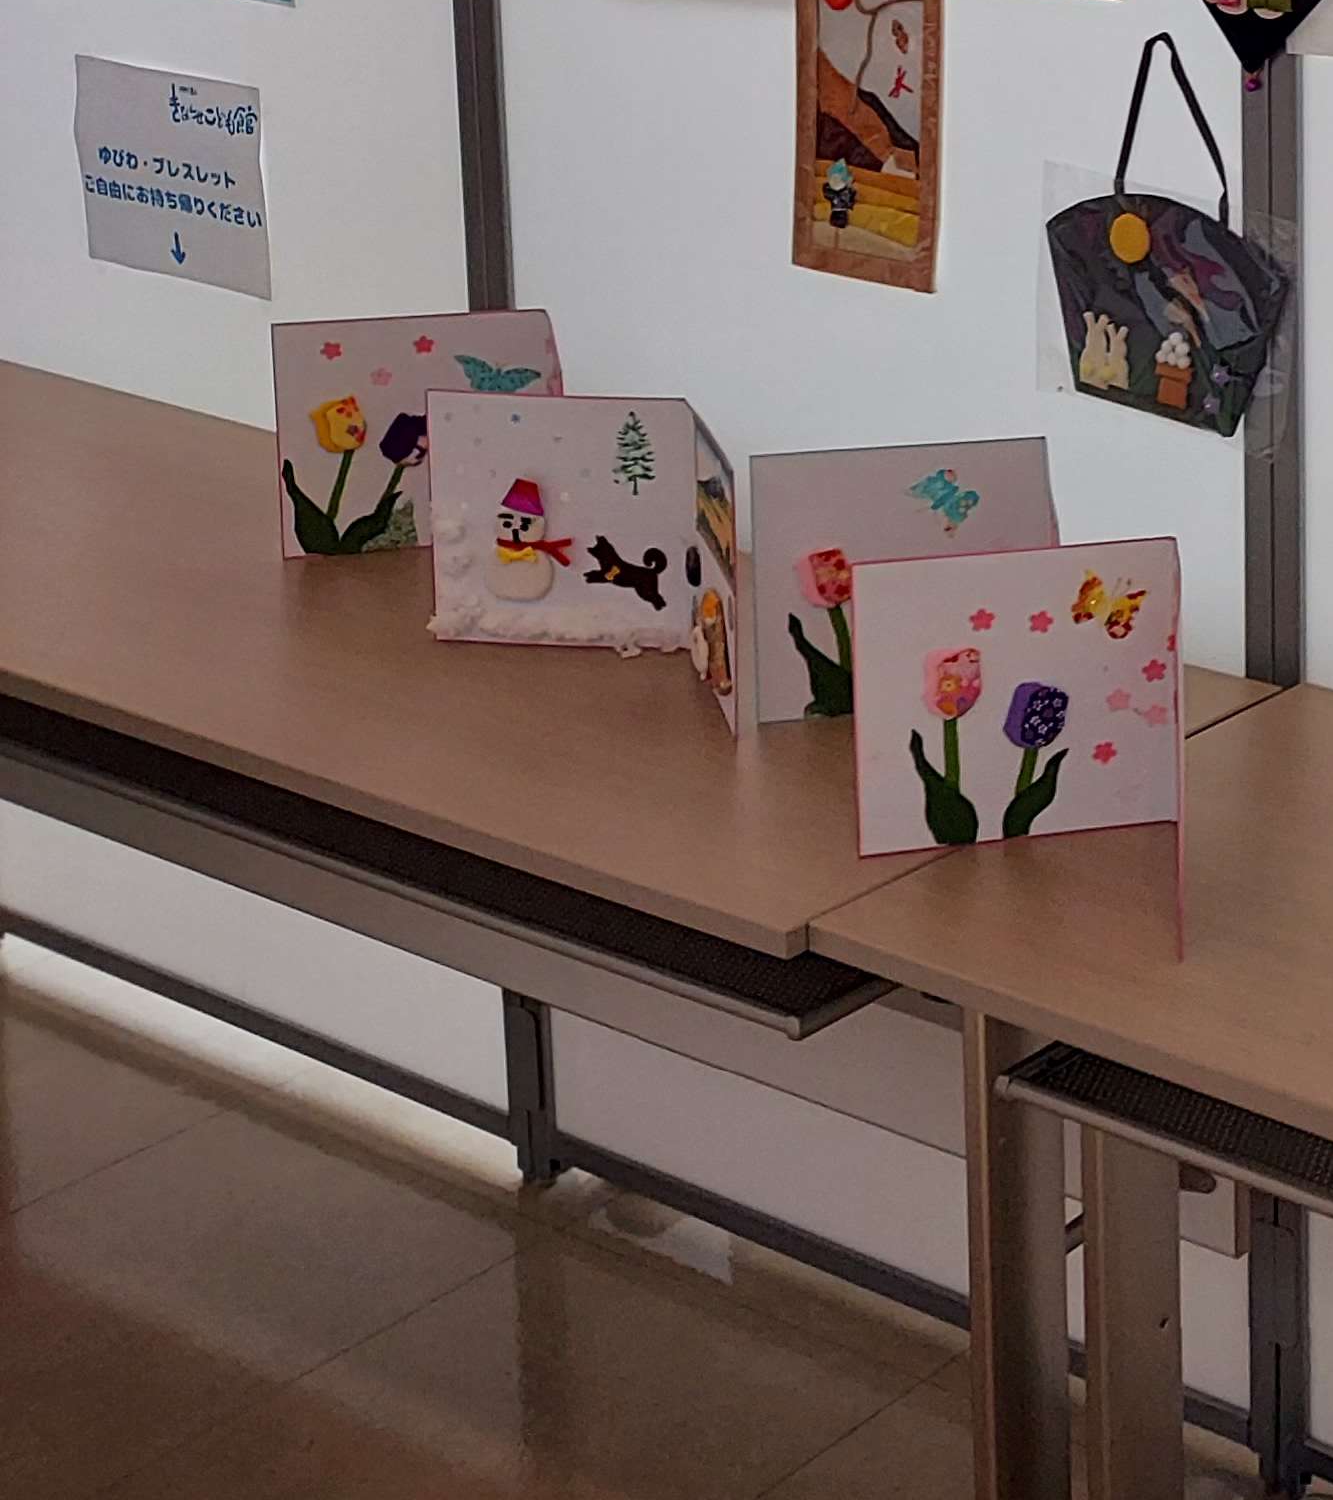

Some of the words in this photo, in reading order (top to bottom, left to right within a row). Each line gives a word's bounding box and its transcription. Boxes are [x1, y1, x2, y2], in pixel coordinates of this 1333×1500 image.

[84, 173, 263, 228] ご自由にお持ち帰りください
